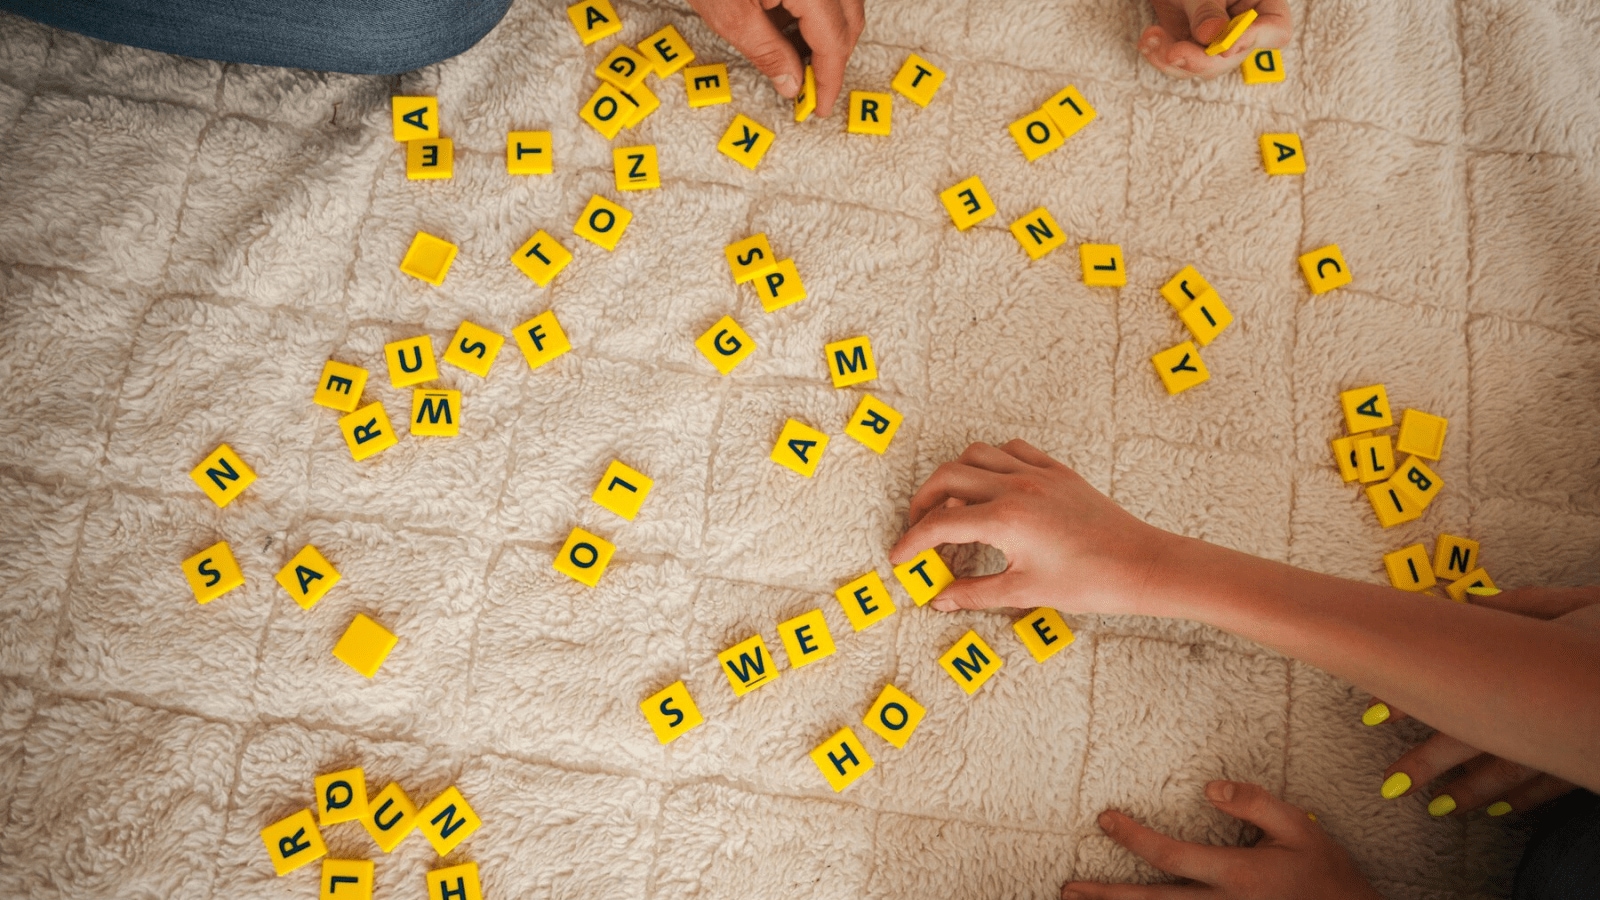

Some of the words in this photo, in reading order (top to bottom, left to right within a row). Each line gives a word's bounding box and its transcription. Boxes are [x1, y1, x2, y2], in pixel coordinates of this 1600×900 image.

[585, 5, 610, 31] A
[653, 37, 679, 63] E
[1254, 50, 1276, 72] D
[608, 56, 637, 78] G
[911, 64, 932, 88] T
[693, 74, 720, 91] E
[402, 106, 429, 131] A
[593, 95, 618, 122] O
[860, 99, 879, 123] R
[1059, 96, 1083, 116] L
[732, 125, 760, 153] K
[1026, 120, 1051, 145] O
[421, 144, 439, 167] E
[516, 142, 542, 161] T
[1273, 142, 1296, 163] A
[627, 153, 647, 179] Z
[958, 188, 981, 215] E
[589, 208, 616, 233] O
[1025, 217, 1054, 245] N
[525, 242, 551, 266] T
[736, 247, 764, 266] S
[1093, 257, 1117, 271] L
[1316, 257, 1341, 279] C
[765, 272, 785, 298] P
[1200, 306, 1217, 327] I
[459, 337, 486, 359] S
[527, 324, 547, 352] F
[713, 329, 742, 356] G
[397, 345, 423, 373] U
[834, 345, 868, 376] M
[1170, 352, 1198, 374] Y
[326, 374, 353, 395] E
[416, 398, 453, 425] W
[1356, 394, 1383, 418] A
[353, 417, 382, 445] R
[860, 409, 890, 435] R
[787, 439, 817, 464] A
[1370, 446, 1385, 472] L
[205, 457, 240, 491] N
[607, 476, 638, 493] L
[1407, 466, 1433, 492] B
[1388, 488, 1404, 513] I
[569, 542, 599, 569] O
[1447, 544, 1471, 575] N
[197, 557, 221, 588] S
[294, 565, 324, 595] A
[1406, 557, 1420, 584] I
[659, 559, 934, 728] SWEET
[827, 616, 1059, 776] HOME
[325, 780, 354, 813] Q
[373, 797, 404, 832] U
[430, 803, 466, 840] N
[278, 827, 311, 859] R
[329, 875, 359, 894] L
[440, 876, 467, 900] H
